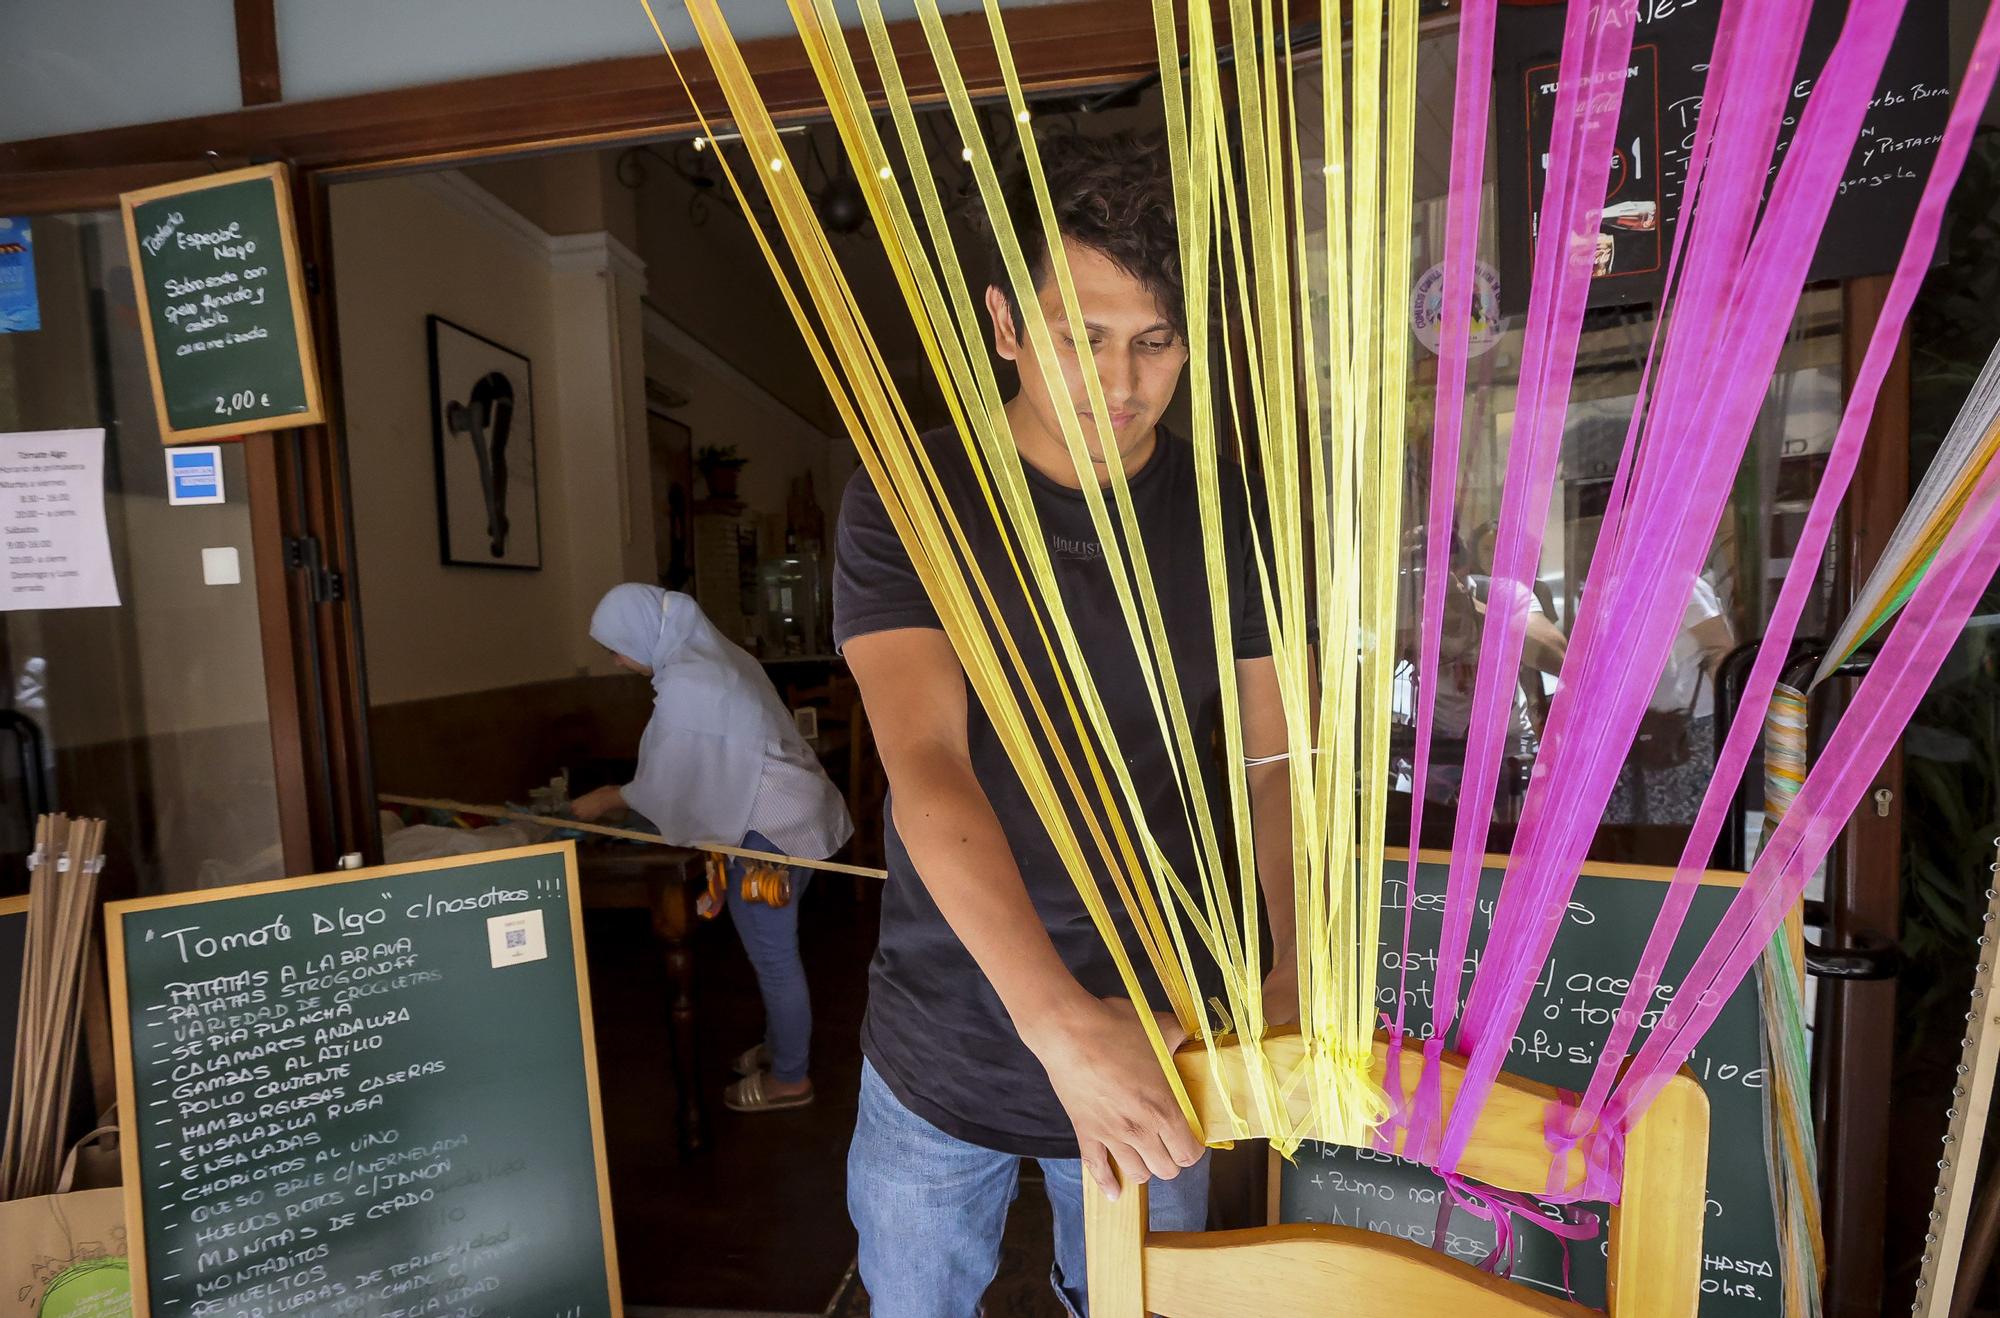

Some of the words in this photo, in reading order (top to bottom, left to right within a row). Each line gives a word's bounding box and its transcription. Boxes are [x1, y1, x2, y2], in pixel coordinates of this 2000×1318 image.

[214, 389, 255, 416] 2,00
[163, 970, 270, 1005] PATATAS
[280, 965, 297, 984] A
[306, 954, 335, 975] LA
[340, 937, 412, 966] BRAVA
[166, 989, 267, 1024] PATATAS
[174, 1004, 289, 1042] VARIEDAD
[296, 996, 321, 1012] DE
[333, 969, 443, 1004] CROQUETAS
[253, 1002, 353, 1038] PLANCHA
[171, 1036, 307, 1082] CALAMARES
[314, 1007, 411, 1045] ANDALUZA
[171, 1065, 272, 1100] GAMBAS
[285, 1055, 313, 1072] AL
[177, 1091, 246, 1119] POLLO
[182, 1086, 346, 1142] HAMBURGUESAS
[358, 1060, 447, 1093] CASERAS
[327, 1094, 384, 1120] RUSA
[180, 1131, 322, 1181] ENSALADAS
[315, 1147, 342, 1164] AL
[190, 1190, 265, 1222] QUESO
[195, 1211, 281, 1248] HUEVOS
[197, 1226, 319, 1273] MANITAS
[328, 1212, 356, 1232] DE
[366, 1188, 435, 1219] CERDO
